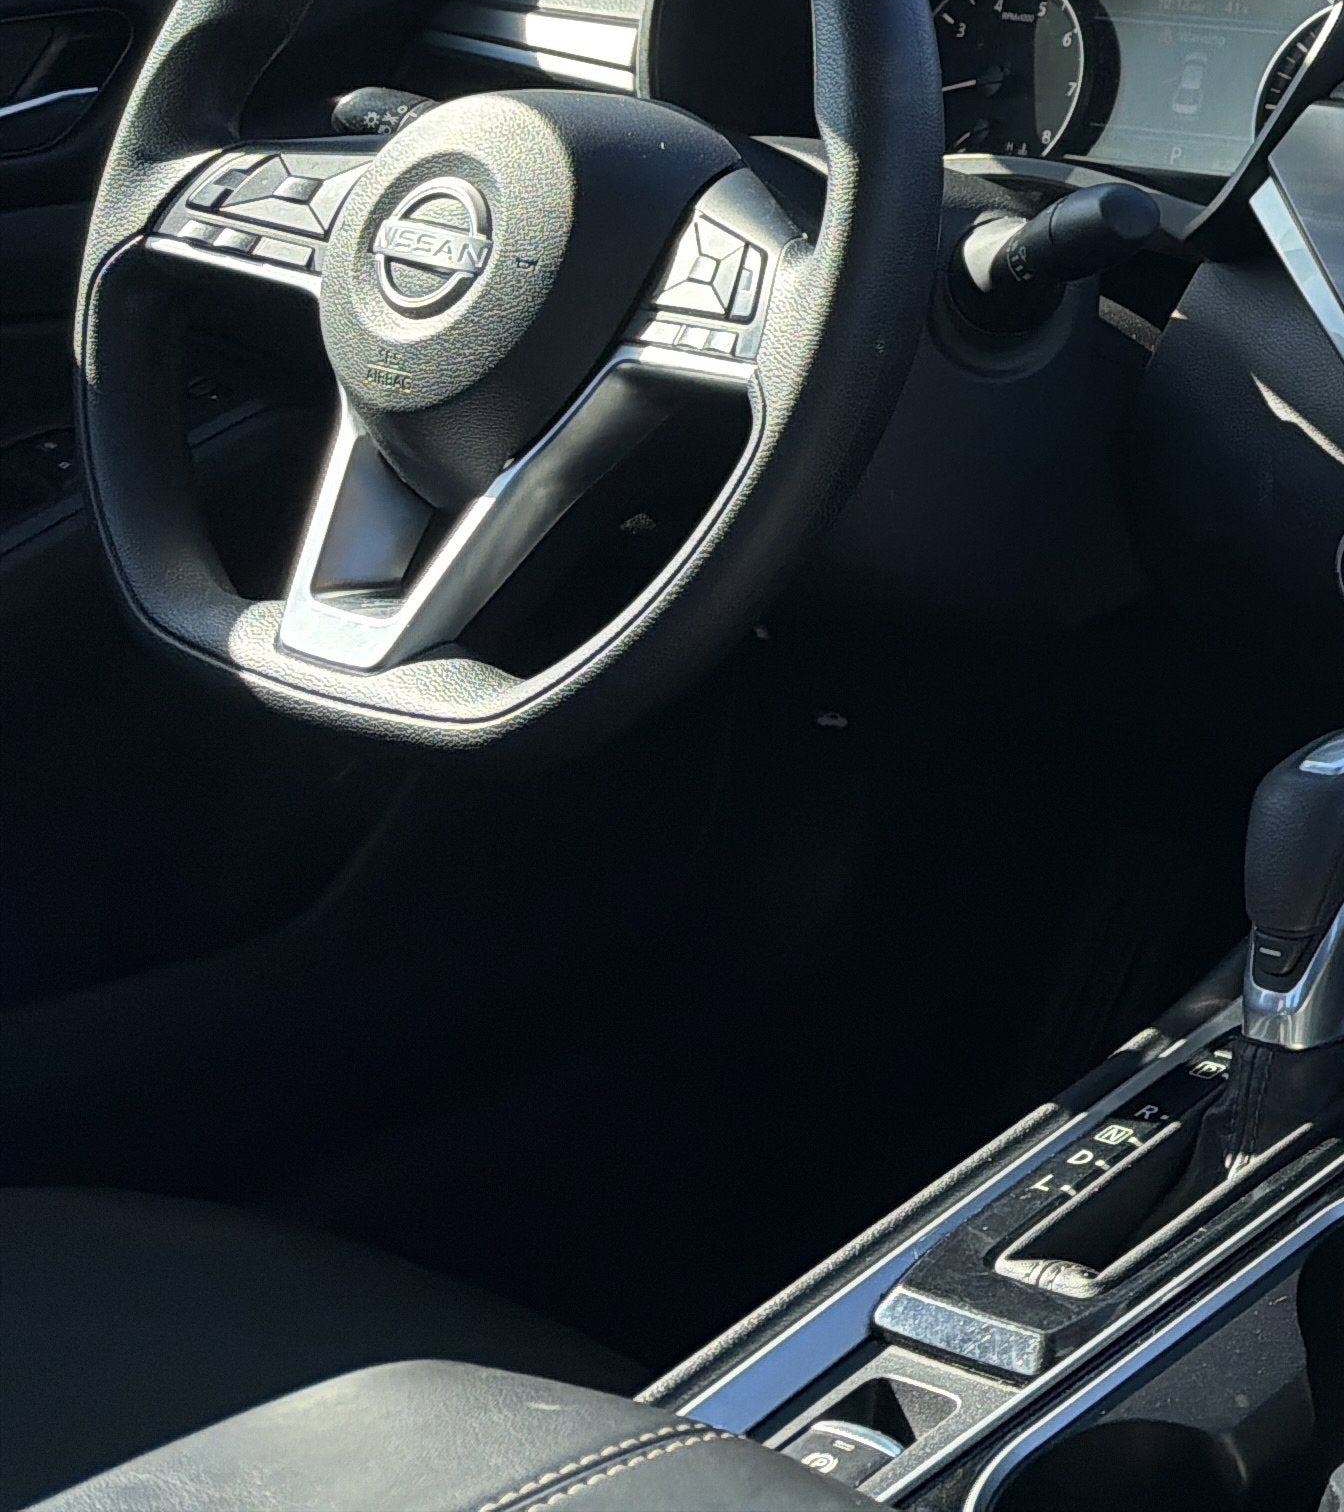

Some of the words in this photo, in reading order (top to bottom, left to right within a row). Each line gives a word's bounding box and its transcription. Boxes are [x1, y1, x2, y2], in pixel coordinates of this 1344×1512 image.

[1037, 1, 1047, 17] 5
[956, 22, 966, 38] 3
[1062, 32, 1073, 48] 6
[1066, 81, 1077, 97] 7
[1041, 129, 1052, 145] 8
[1171, 146, 1182, 166] P
[379, 227, 489, 268] NISSAN
[366, 368, 413, 391] AIRBAG
[1134, 1105, 1159, 1120] R
[1067, 1149, 1094, 1165] D
[1031, 1174, 1054, 1192] L
